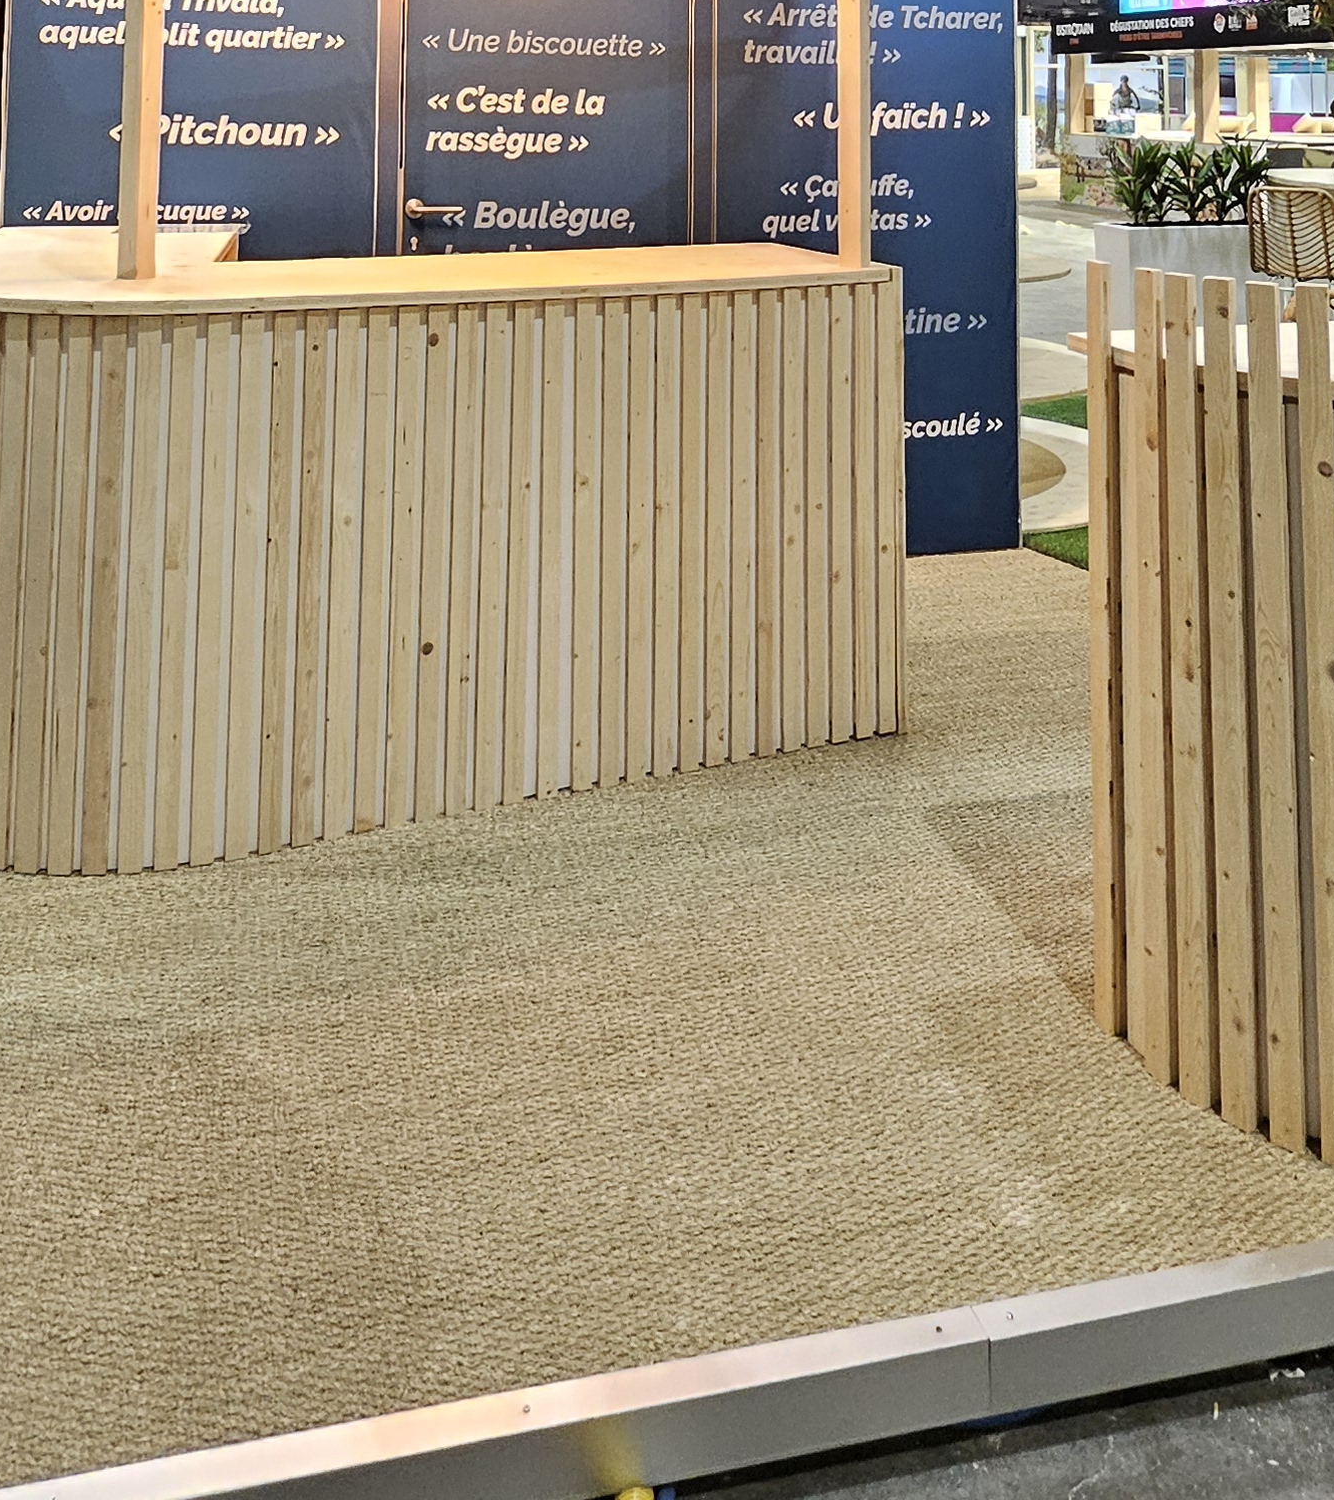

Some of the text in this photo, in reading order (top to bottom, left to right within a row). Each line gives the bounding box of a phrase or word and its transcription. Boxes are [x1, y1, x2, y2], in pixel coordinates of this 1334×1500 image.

[900, 4, 1004, 34] Tcharer,
[1110, 15, 1195, 33] DÉGUSTATION DES CHEFS
[205, 25, 322, 53] quartier
[447, 27, 644, 58] Une biscouette
[455, 85, 606, 116] C'est de la
[870, 102, 947, 137] faïch
[425, 126, 563, 160] rassègue
[45, 200, 113, 222] Avoir
[473, 200, 636, 238] Boulègue,
[761, 209, 820, 239] quel
[904, 307, 962, 335] tine
[903, 411, 981, 440] scoulé
